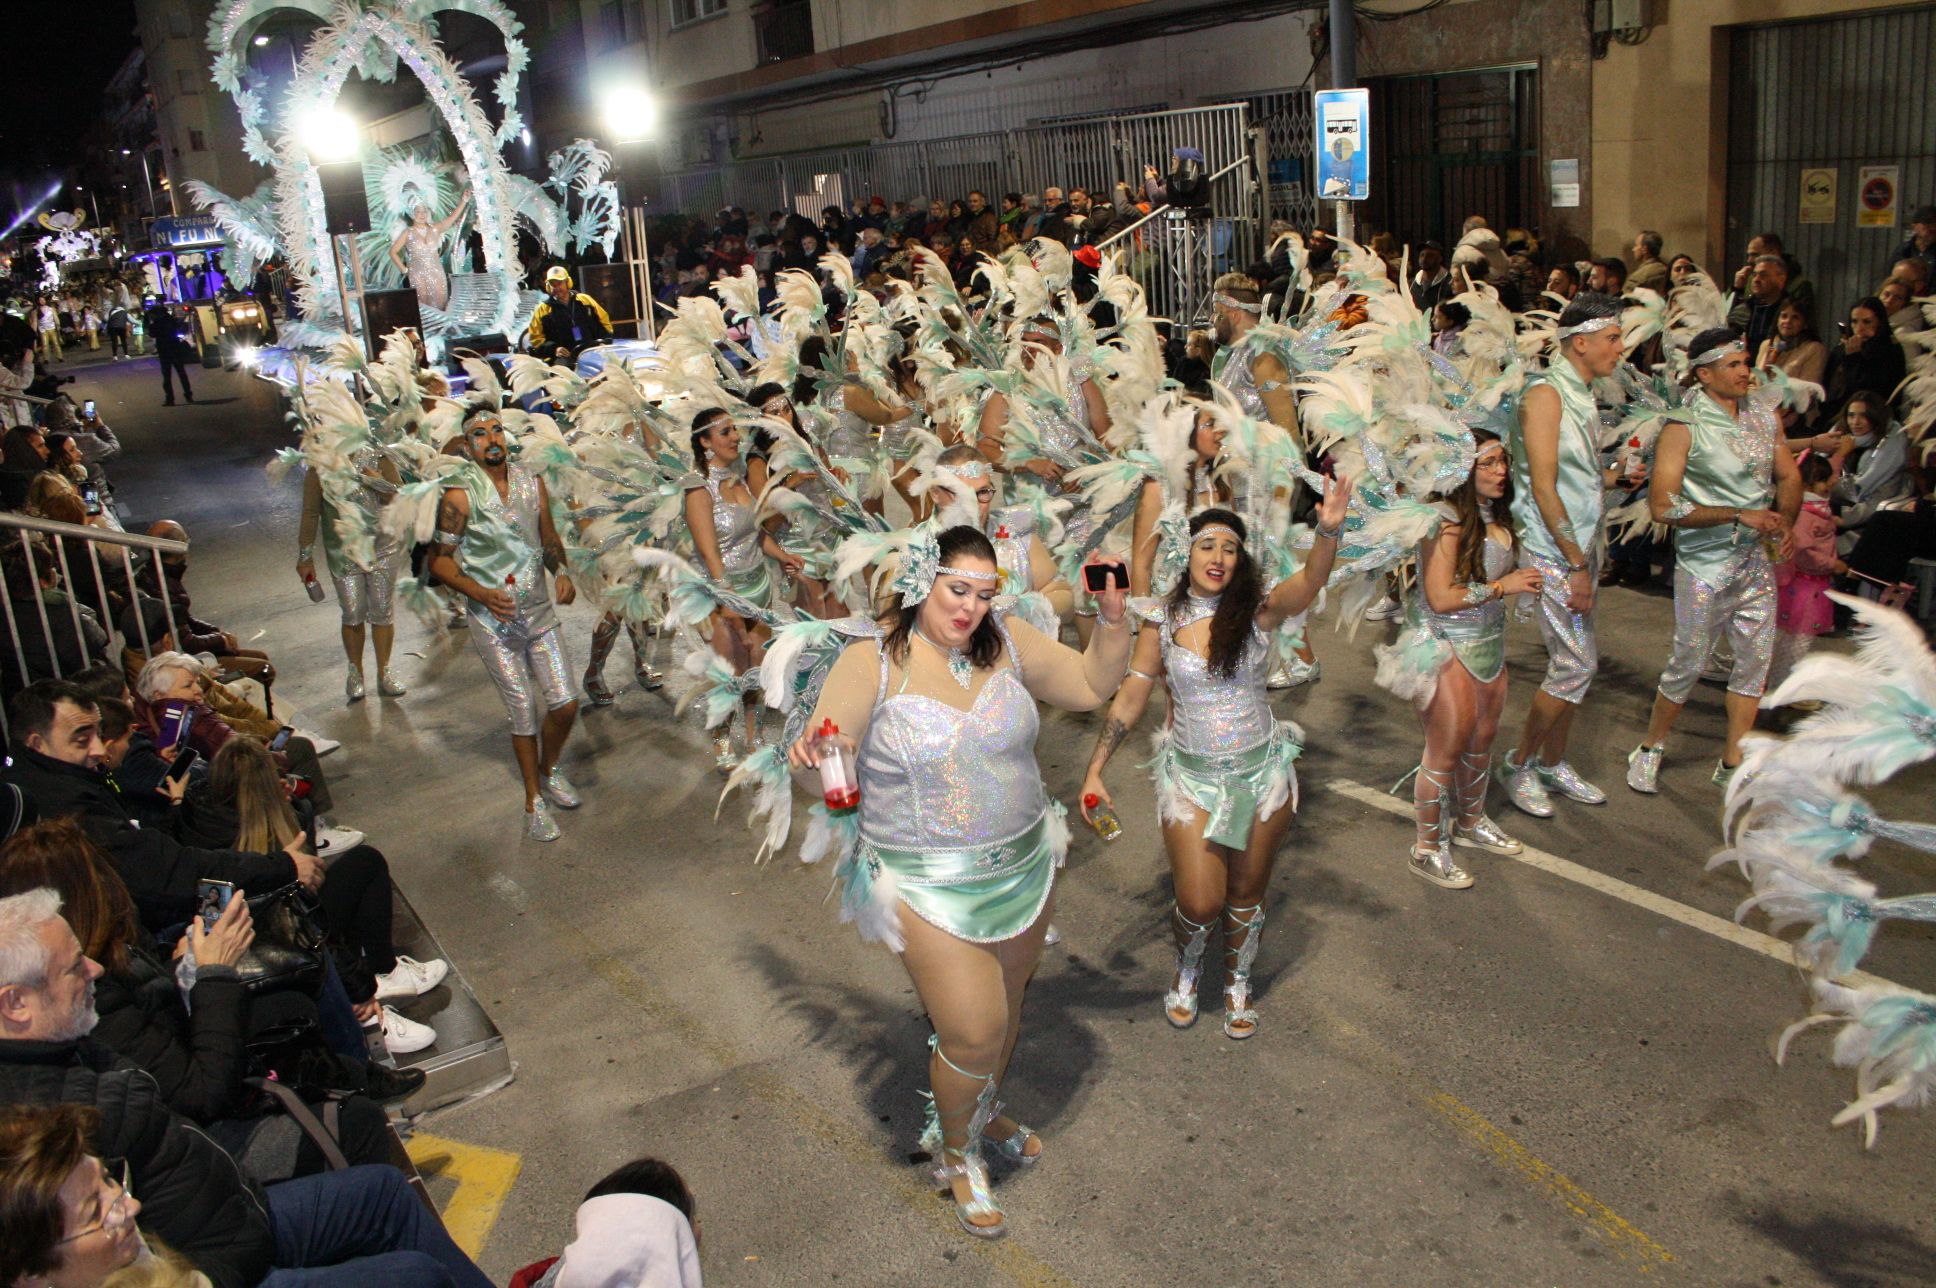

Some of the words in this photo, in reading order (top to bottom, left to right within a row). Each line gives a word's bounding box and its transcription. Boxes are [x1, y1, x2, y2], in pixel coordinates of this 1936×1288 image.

[173, 216, 215, 228] COMPARS
[157, 231, 173, 244] NI
[179, 229, 198, 243] FU
